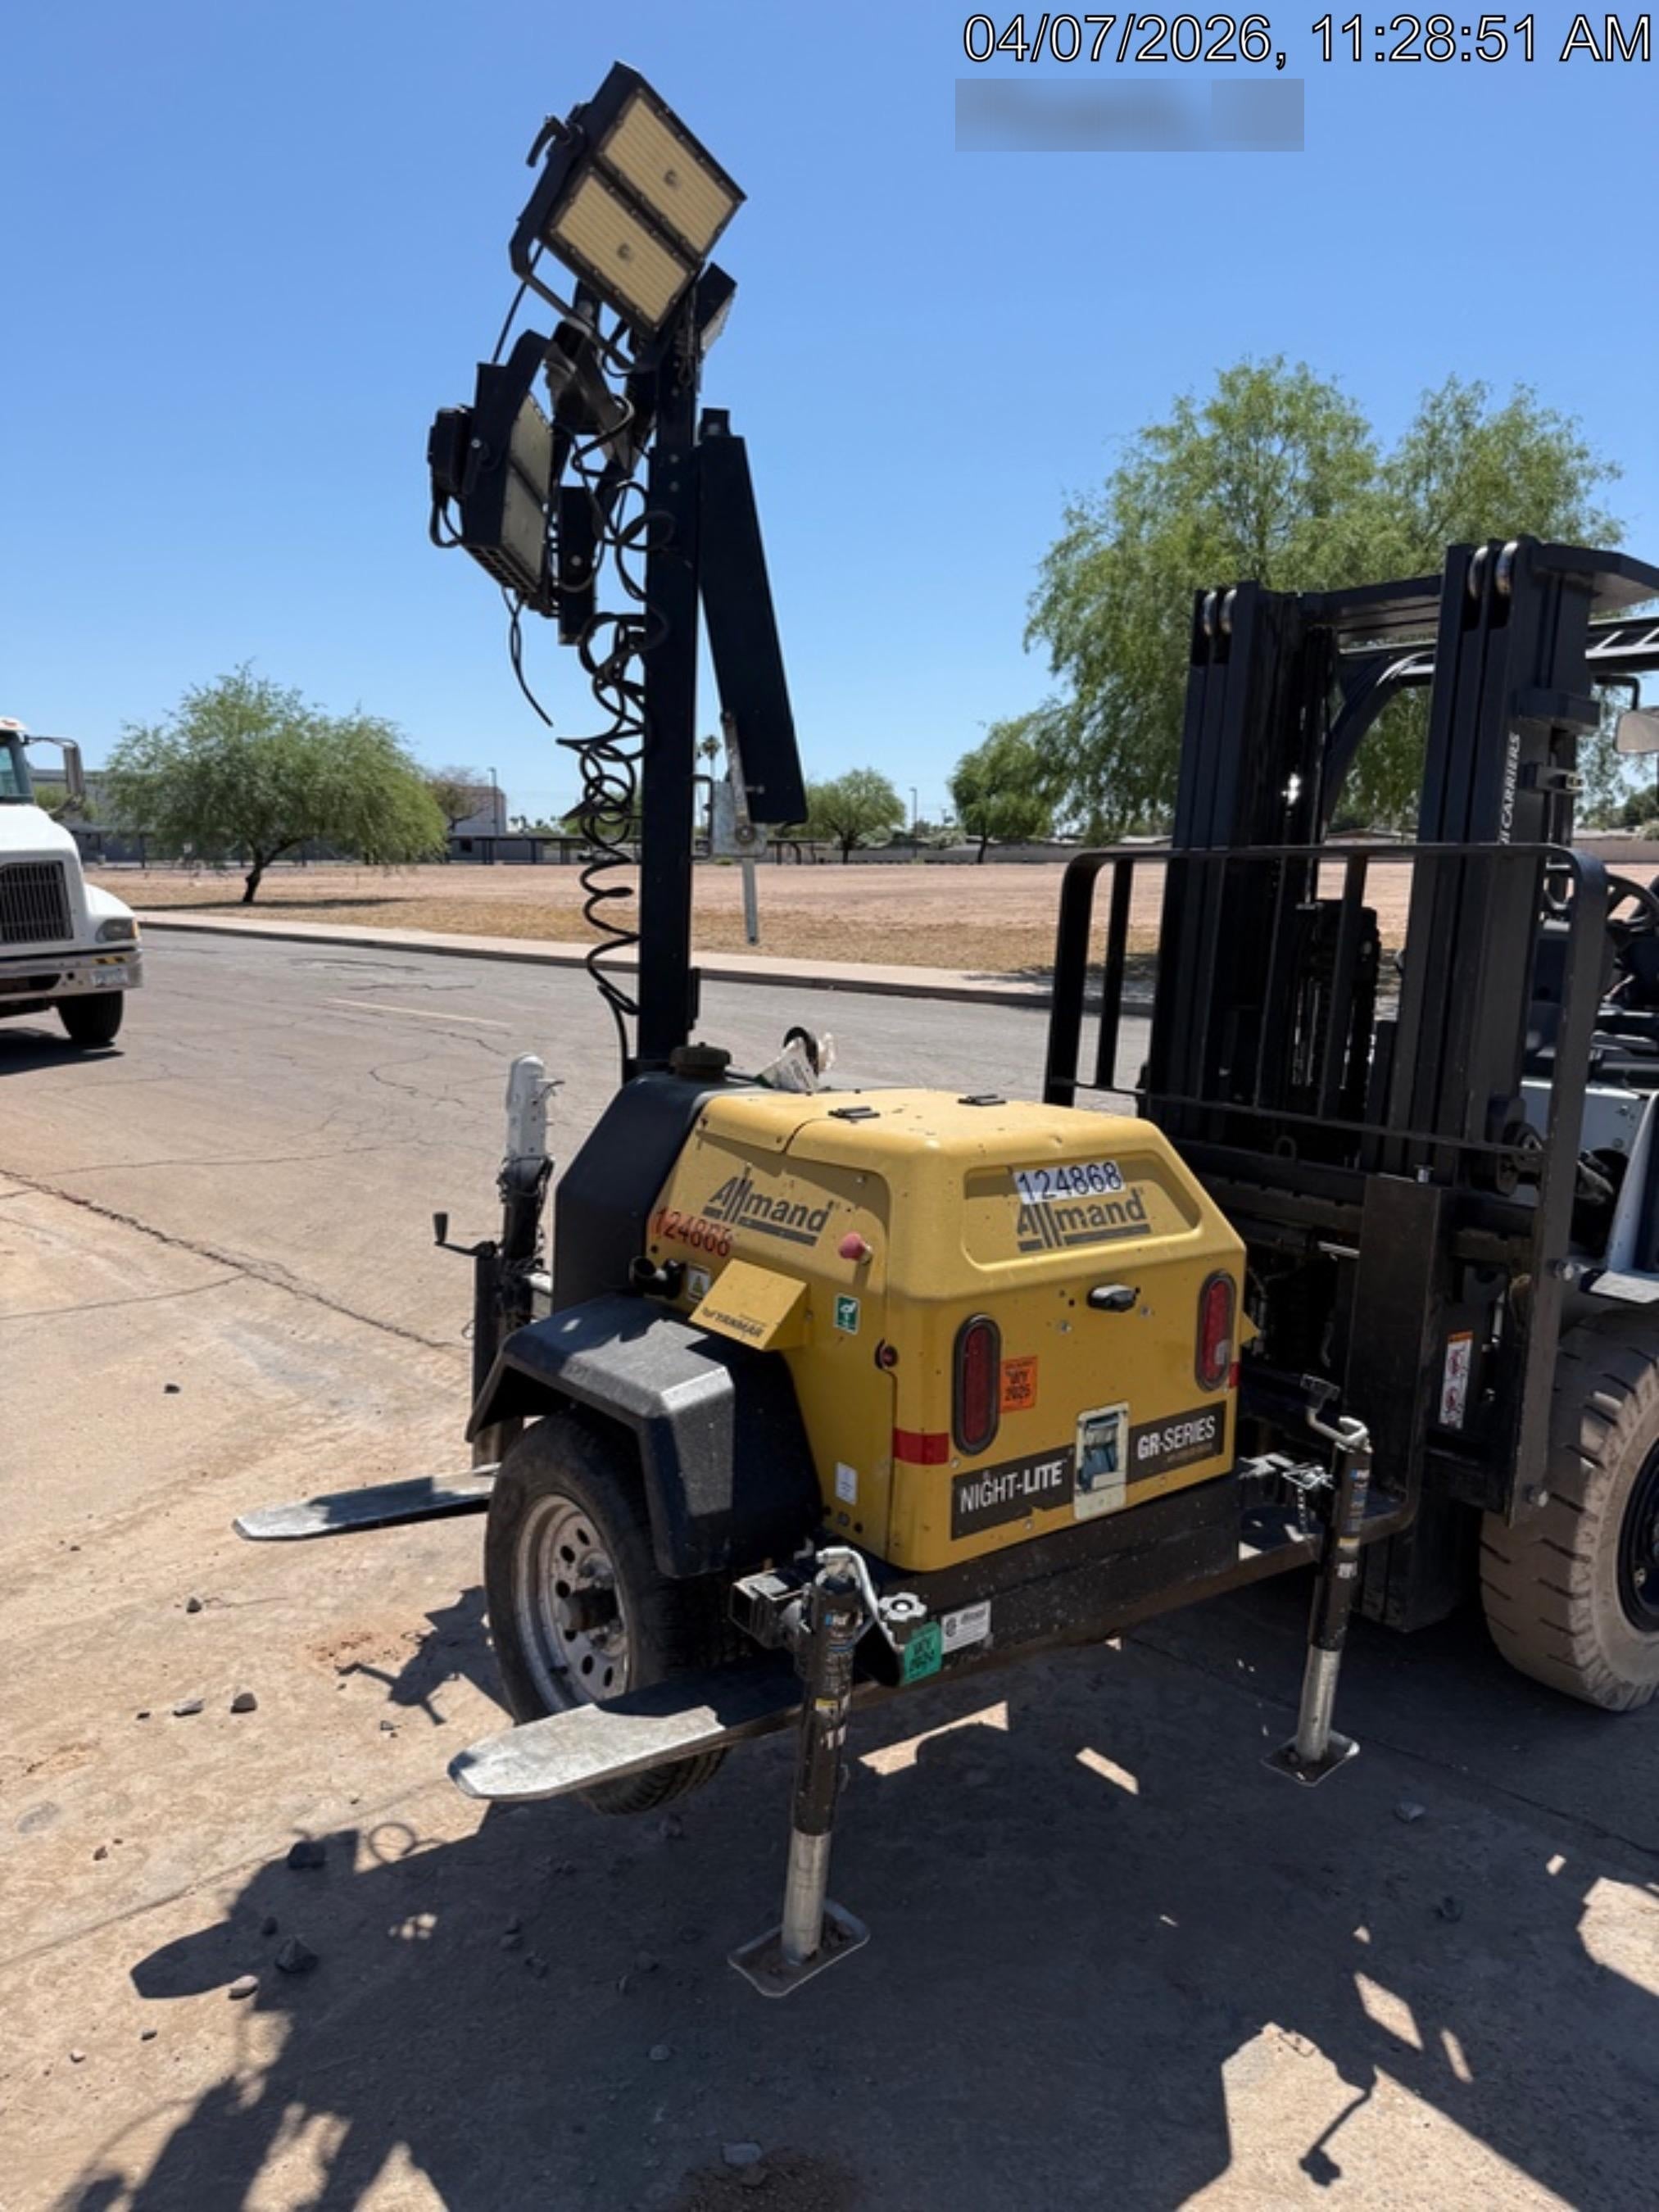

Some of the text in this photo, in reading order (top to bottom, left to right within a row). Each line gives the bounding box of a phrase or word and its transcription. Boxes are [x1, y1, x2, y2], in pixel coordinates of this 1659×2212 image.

[709, 1175, 834, 1231] Allmand
[1018, 1162, 1122, 1201] 124868
[1017, 1190, 1146, 1248] Allmand
[1137, 1416, 1216, 1460] GR-SERIES
[960, 1462, 1063, 1514] NIGHT-LITE
